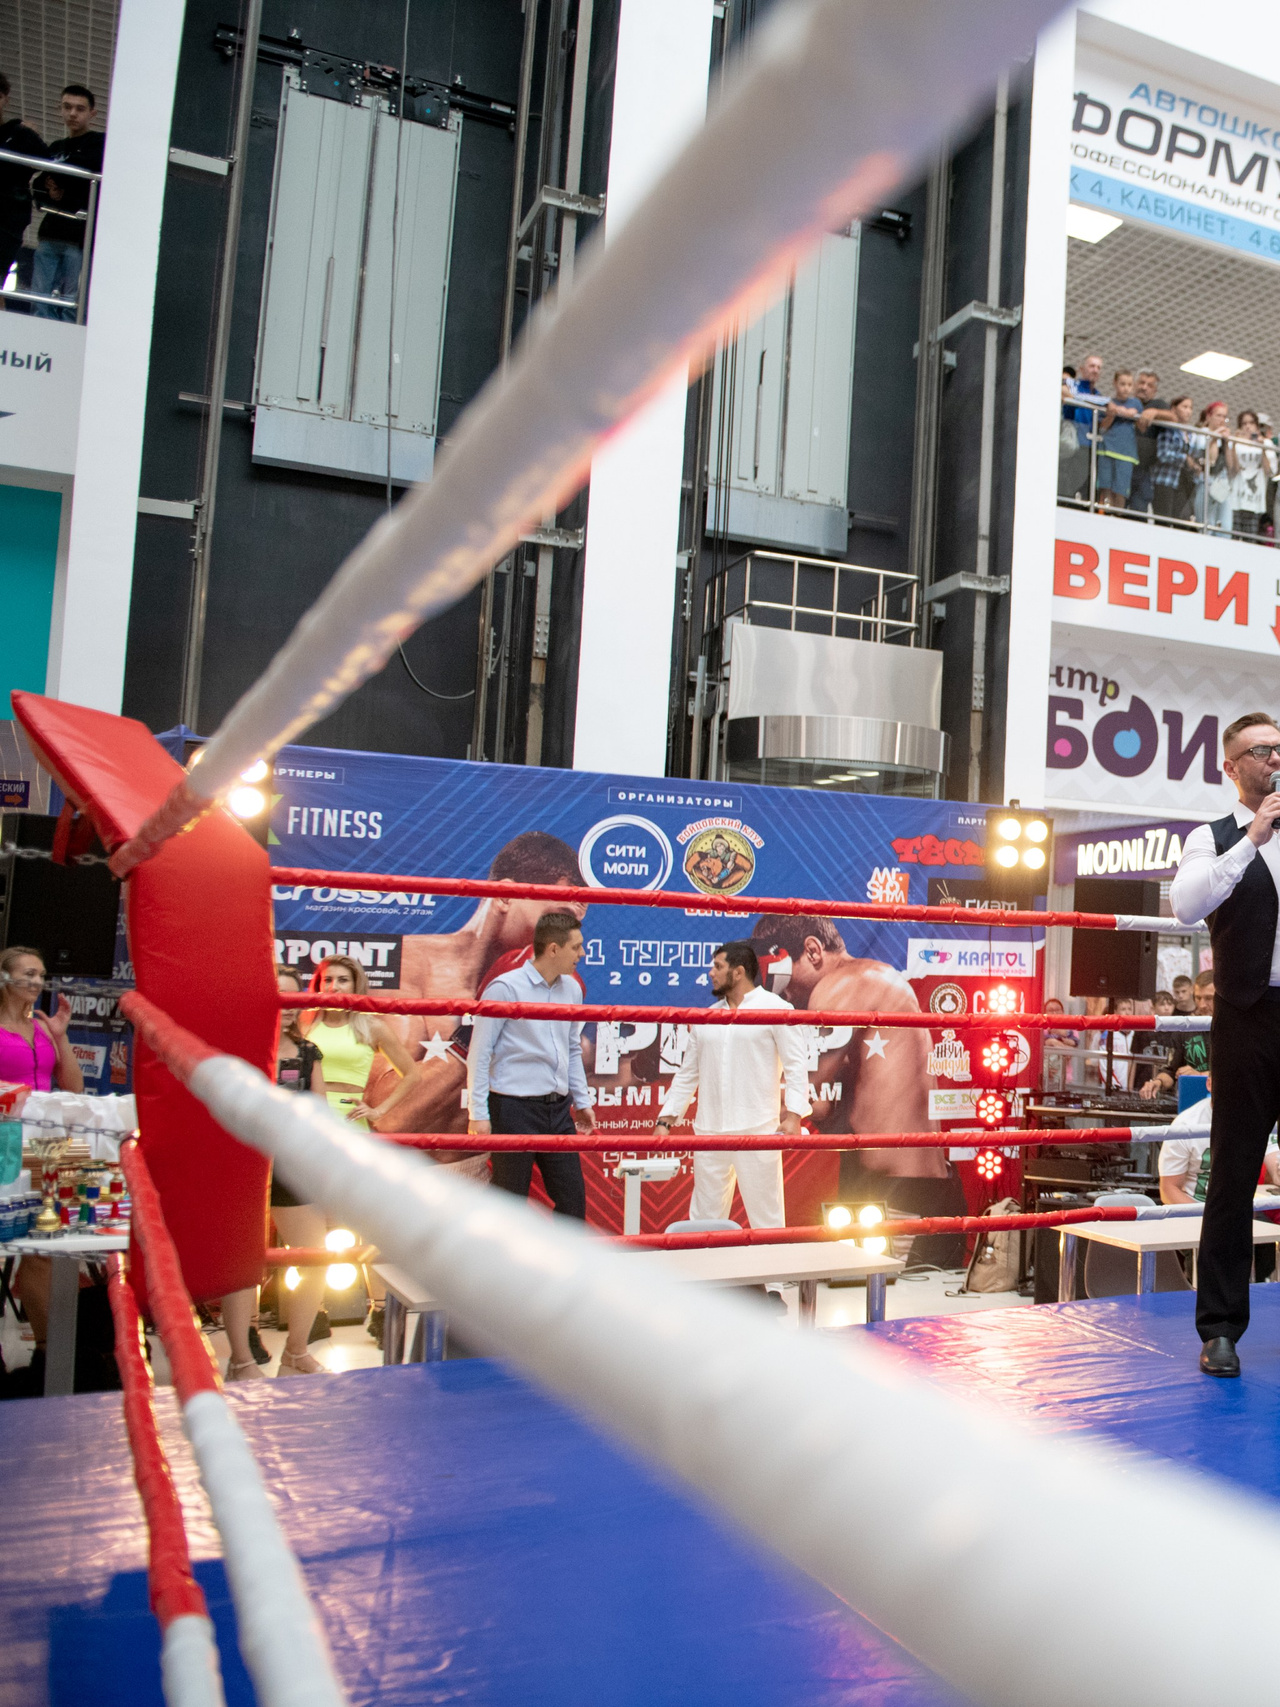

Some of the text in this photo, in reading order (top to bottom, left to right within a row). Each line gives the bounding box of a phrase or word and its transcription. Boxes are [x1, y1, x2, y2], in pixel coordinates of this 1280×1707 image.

[1053, 538, 1250, 627] ВЕРИ
[272, 768, 337, 781] АРТНЕРЫ
[617, 791, 734, 809] ОРГАНИЗАТОРЫ
[287, 806, 383, 840] FITNESS
[957, 816, 987, 826] ПАРТ
[678, 817, 764, 849] БОЙЦОВСКИЙ КЛУБ
[606, 844, 647, 858] СИТИ
[1076, 828, 1183, 876] MODNIZZA
[603, 862, 649, 876] МОЛЛ
[304, 903, 347, 913] магазин
[403, 907, 409, 915] 2
[411, 908, 434, 916] этаж
[274, 938, 398, 968] RPOINT
[620, 940, 723, 967] ТУРНИ
[957, 951, 1026, 967] KAPITOL
[630, 1119, 654, 1130] ДНЮ
